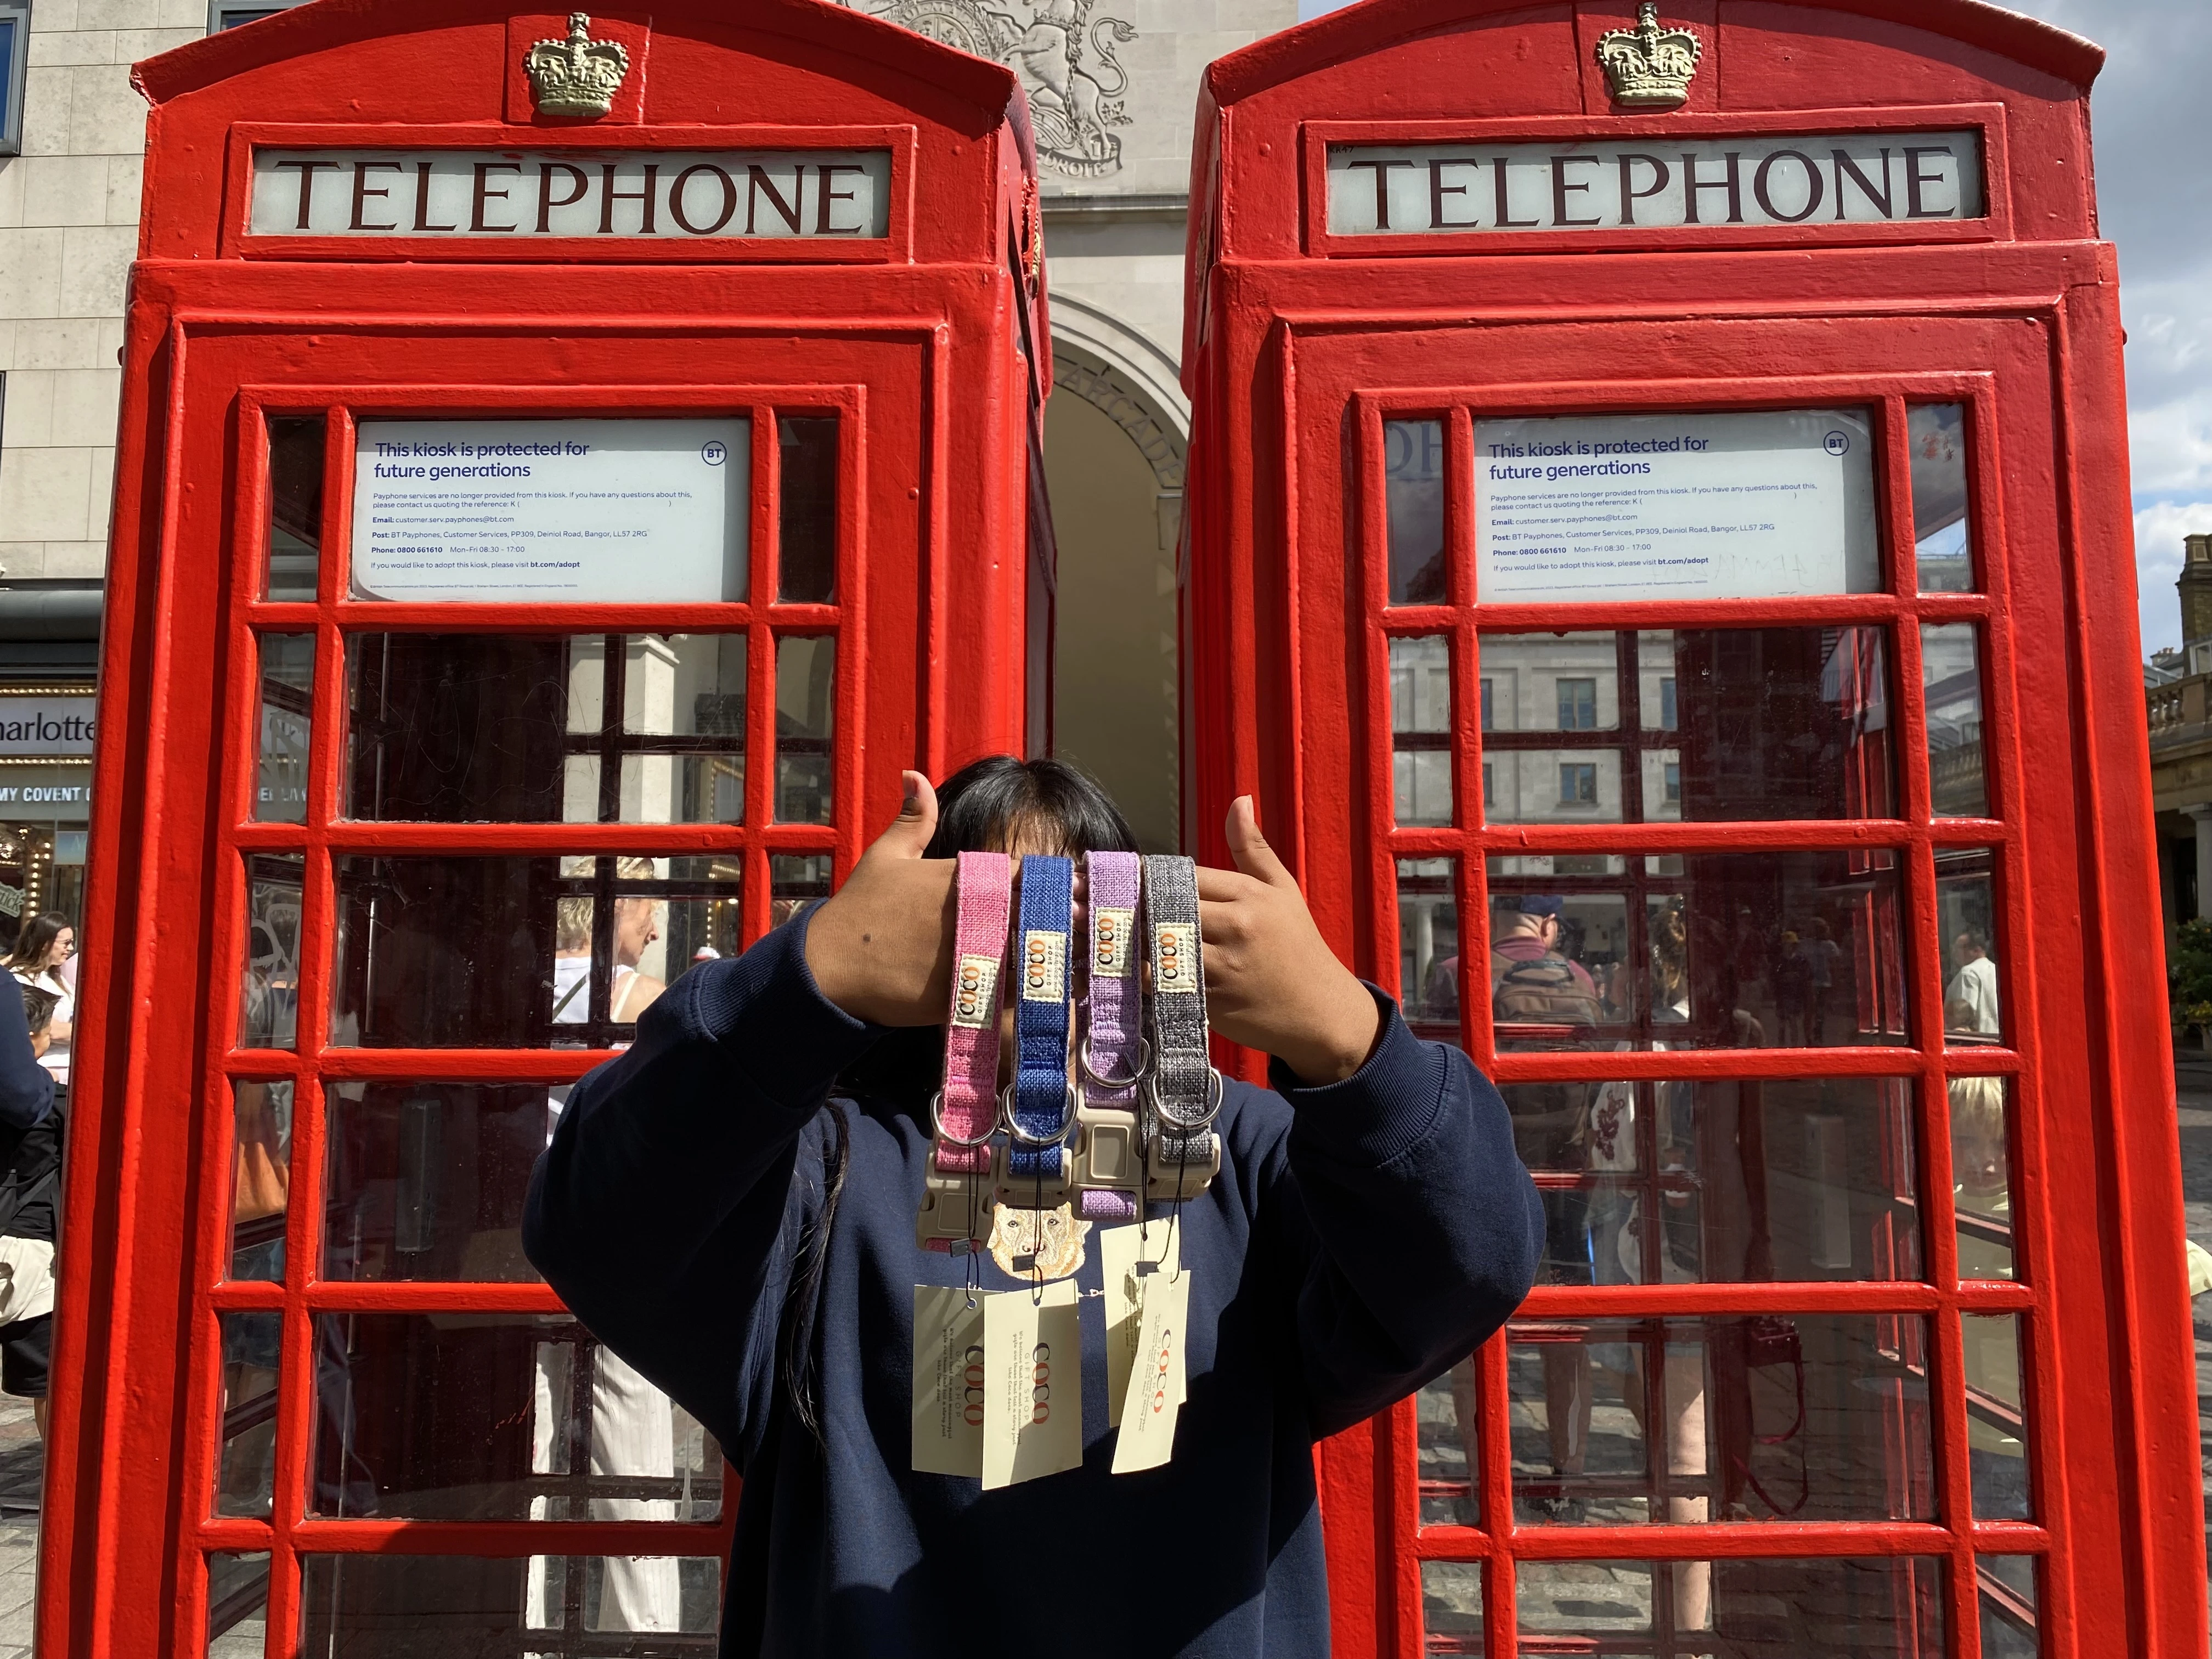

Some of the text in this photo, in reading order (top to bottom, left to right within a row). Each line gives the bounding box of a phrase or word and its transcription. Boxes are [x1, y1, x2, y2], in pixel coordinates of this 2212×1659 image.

[1347, 146, 1956, 229] TELEPHONE
[274, 161, 865, 235] TELEPHONE
[375, 441, 589, 459] This kiosk is protected for
[1488, 436, 1708, 458] This kiosk is protected for
[1829, 438, 1843, 448] BT
[707, 448, 721, 458] BT
[374, 462, 530, 481] future generations
[1489, 460, 1651, 480] future generations
[373, 493, 408, 501] Payphone
[460, 492, 483, 500] longer
[484, 492, 515, 500] provided
[1491, 494, 1526, 503] Payphone
[1580, 491, 1604, 499] longer
[1605, 489, 1637, 499] provided
[1744, 484, 1779, 493] questions
[433, 501, 460, 509] quoting
[1491, 504, 1514, 512] please
[1553, 501, 1581, 509] quoting
[395, 516, 514, 524] customer.serv.payphones@bt.com
[1515, 514, 1638, 525] customer.serv.payphones@bt.com
[402, 531, 442, 539] Payphones,
[584, 531, 612, 539] Bangor,
[1523, 533, 1565, 541] Payphones,
[530, 561, 580, 569] bt.com/adopt
[1657, 557, 1709, 565] bt.com/adopt
[0, 712, 94, 741] arlotte
[23, 787, 81, 802] COVENT
[1098, 918, 1114, 965] COCO
[1029, 940, 1045, 988] COCO
[1160, 933, 1178, 980] COCO
[960, 966, 980, 1015] COCO
[1153, 1328, 1172, 1414] COCO
[963, 1345, 985, 1426] COCO
[1031, 1342, 1050, 1425] COCO
